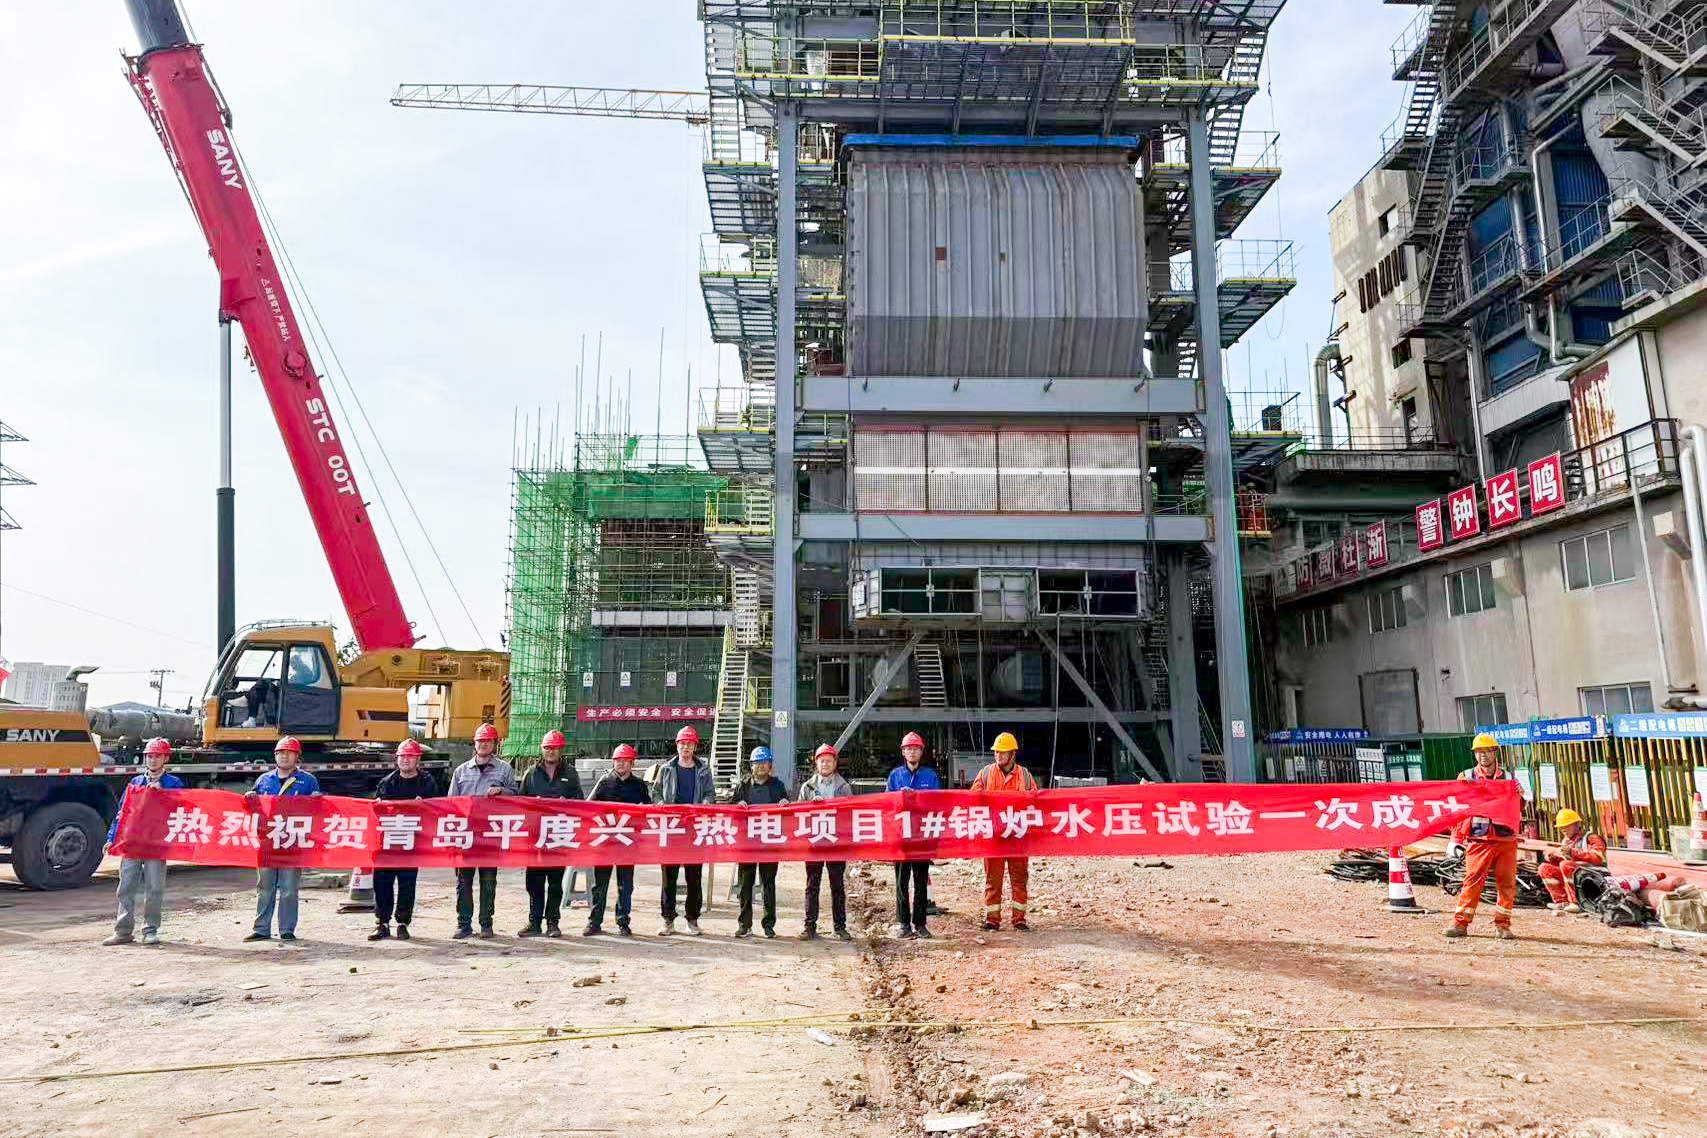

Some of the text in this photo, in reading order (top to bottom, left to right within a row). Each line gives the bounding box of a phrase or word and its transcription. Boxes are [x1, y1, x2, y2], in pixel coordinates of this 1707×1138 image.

[207, 129, 242, 189] SANY
[306, 398, 335, 442] STC
[1418, 463, 1558, 543] 警钟长鸣
[586, 707, 661, 718] 生产必须安全
[6, 729, 60, 742] SANY
